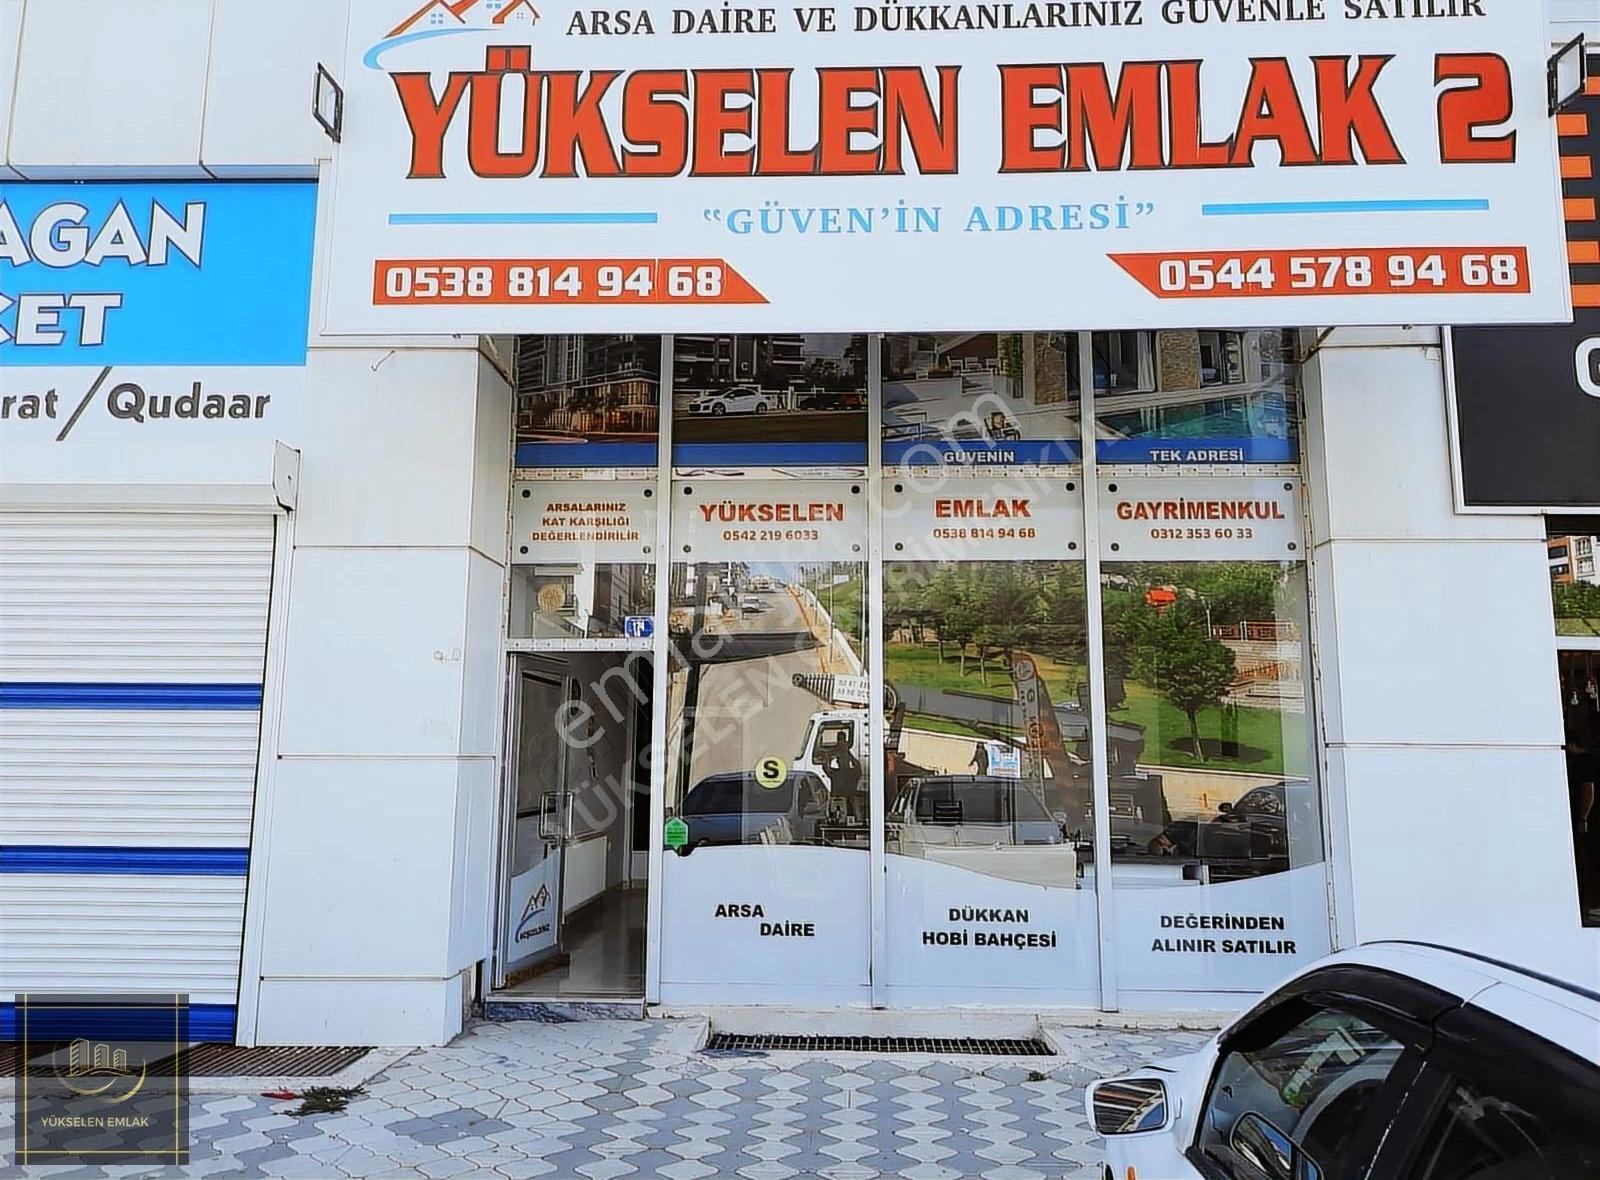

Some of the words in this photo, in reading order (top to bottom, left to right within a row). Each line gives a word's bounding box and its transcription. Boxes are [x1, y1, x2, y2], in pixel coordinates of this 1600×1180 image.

[566, 10, 655, 36] ARSA
[671, 1, 777, 35] DAİRE
[793, 7, 836, 33] VE
[853, 0, 1143, 32] DÜKKANLARINIZ
[390, 45, 962, 179] YÜKSELEN
[996, 56, 1407, 173] EMLAK
[1433, 53, 1517, 164] 2
[1158, 258, 1276, 292] 0544
[1290, 255, 1372, 290] 578
[1388, 254, 1446, 287] 94
[1461, 253, 1519, 287] 68
[385, 265, 493, 299] 0538
[507, 265, 583, 299] 814
[597, 265, 653, 299] 94
[667, 265, 723, 299] 68
[1150, 450, 1183, 461] TEK
[1186, 447, 1244, 461] ADRESİ
[546, 503, 627, 512] ARSALARINIZ
[699, 500, 844, 522] YÜKSELEN
[935, 499, 1031, 518] EMLAK
[1116, 497, 1285, 520] GAYRİMENKUL
[542, 517, 566, 526] KAT
[569, 516, 629, 528] KARŞILIĞI
[532, 530, 639, 541] DEĞERLENDİRİLİR
[723, 530, 756, 541] 0542
[760, 530, 782, 541] 219
[786, 530, 819, 541] 6033
[933, 528, 967, 538] 0538
[970, 528, 994, 538] 814
[998, 528, 1015, 538] 94
[1018, 528, 1036, 538] 68
[1151, 528, 1183, 539] 0312
[1186, 528, 1211, 539] 353
[1215, 528, 1233, 539] 60
[1236, 528, 1253, 539] 33
[763, 760, 779, 779] S
[715, 904, 765, 918] ARSA
[948, 905, 1029, 923] DÜKKAN
[760, 919, 815, 936] DAİRE
[1160, 913, 1285, 930] DEĞERİNDEN
[922, 929, 969, 946] HOBİ
[974, 931, 1057, 950] BAHÇESİ
[1151, 939, 1216, 953] ALINIR
[1221, 940, 1297, 954] SATILIR
